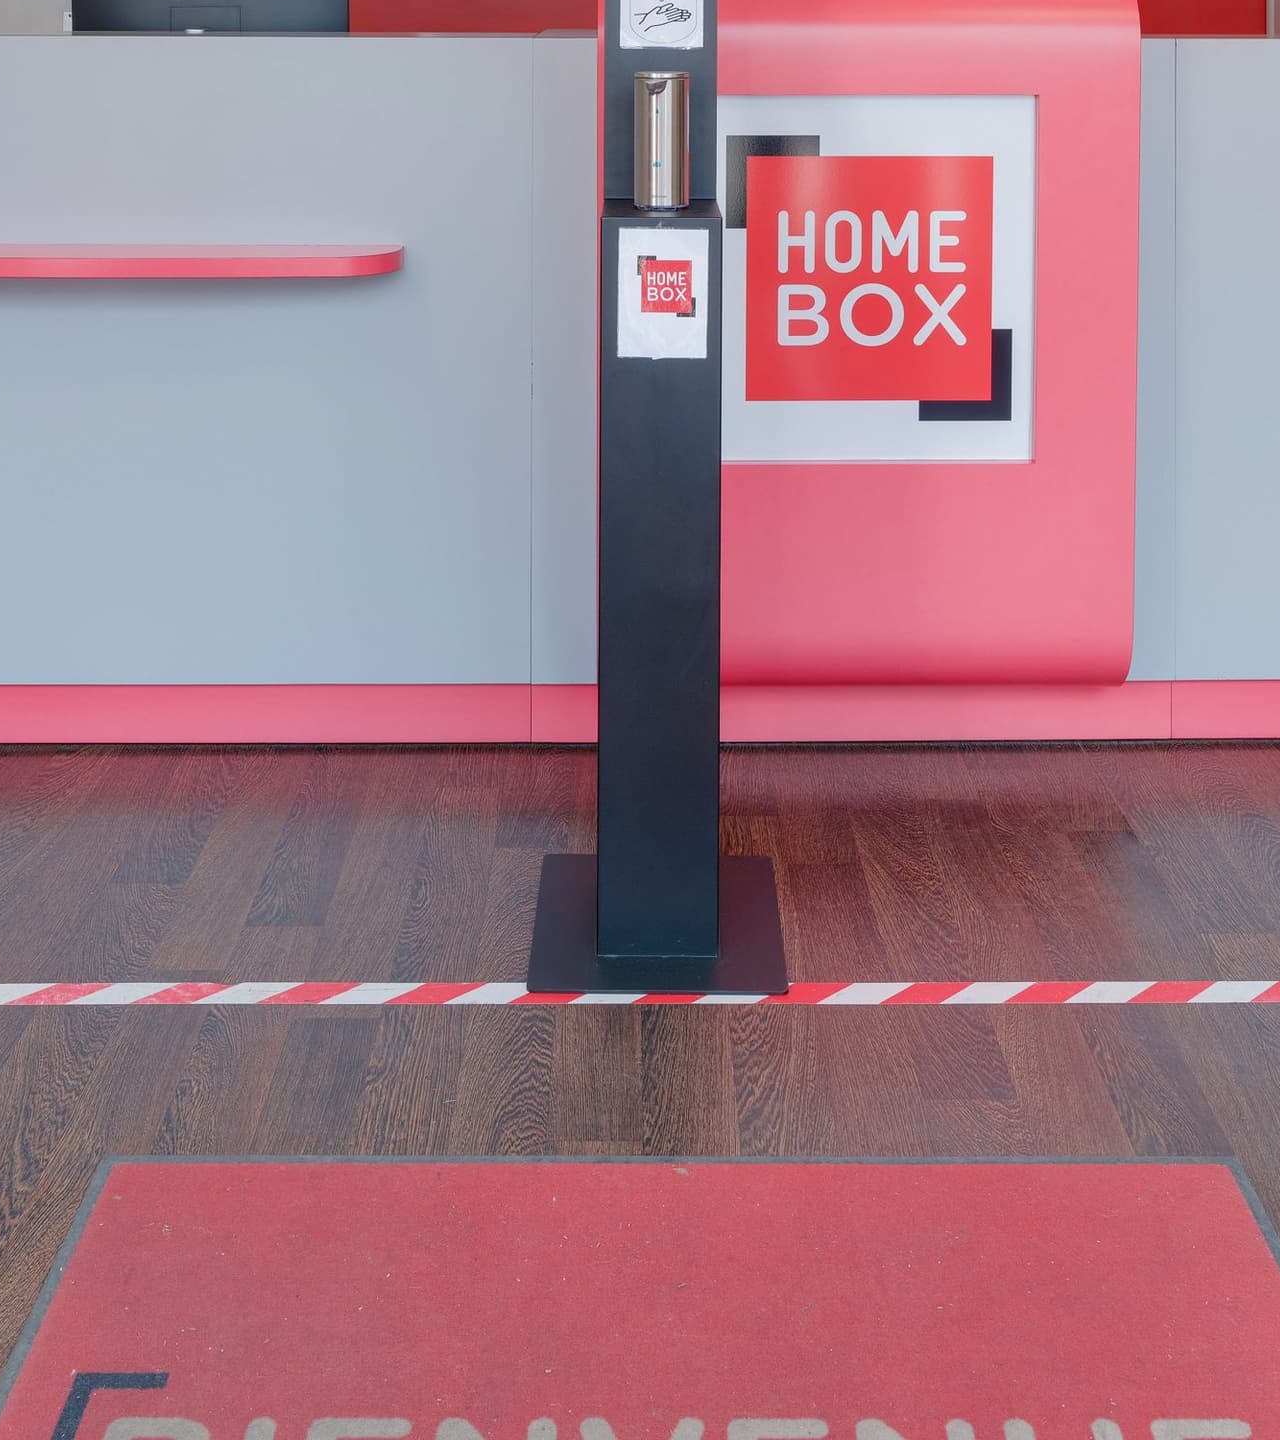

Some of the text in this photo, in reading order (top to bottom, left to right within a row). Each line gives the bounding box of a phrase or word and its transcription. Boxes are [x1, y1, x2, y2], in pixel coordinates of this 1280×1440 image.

[777, 210, 967, 274] HOME
[647, 271, 687, 286] HOME
[647, 287, 687, 302] BOX
[777, 283, 967, 347] BOX
